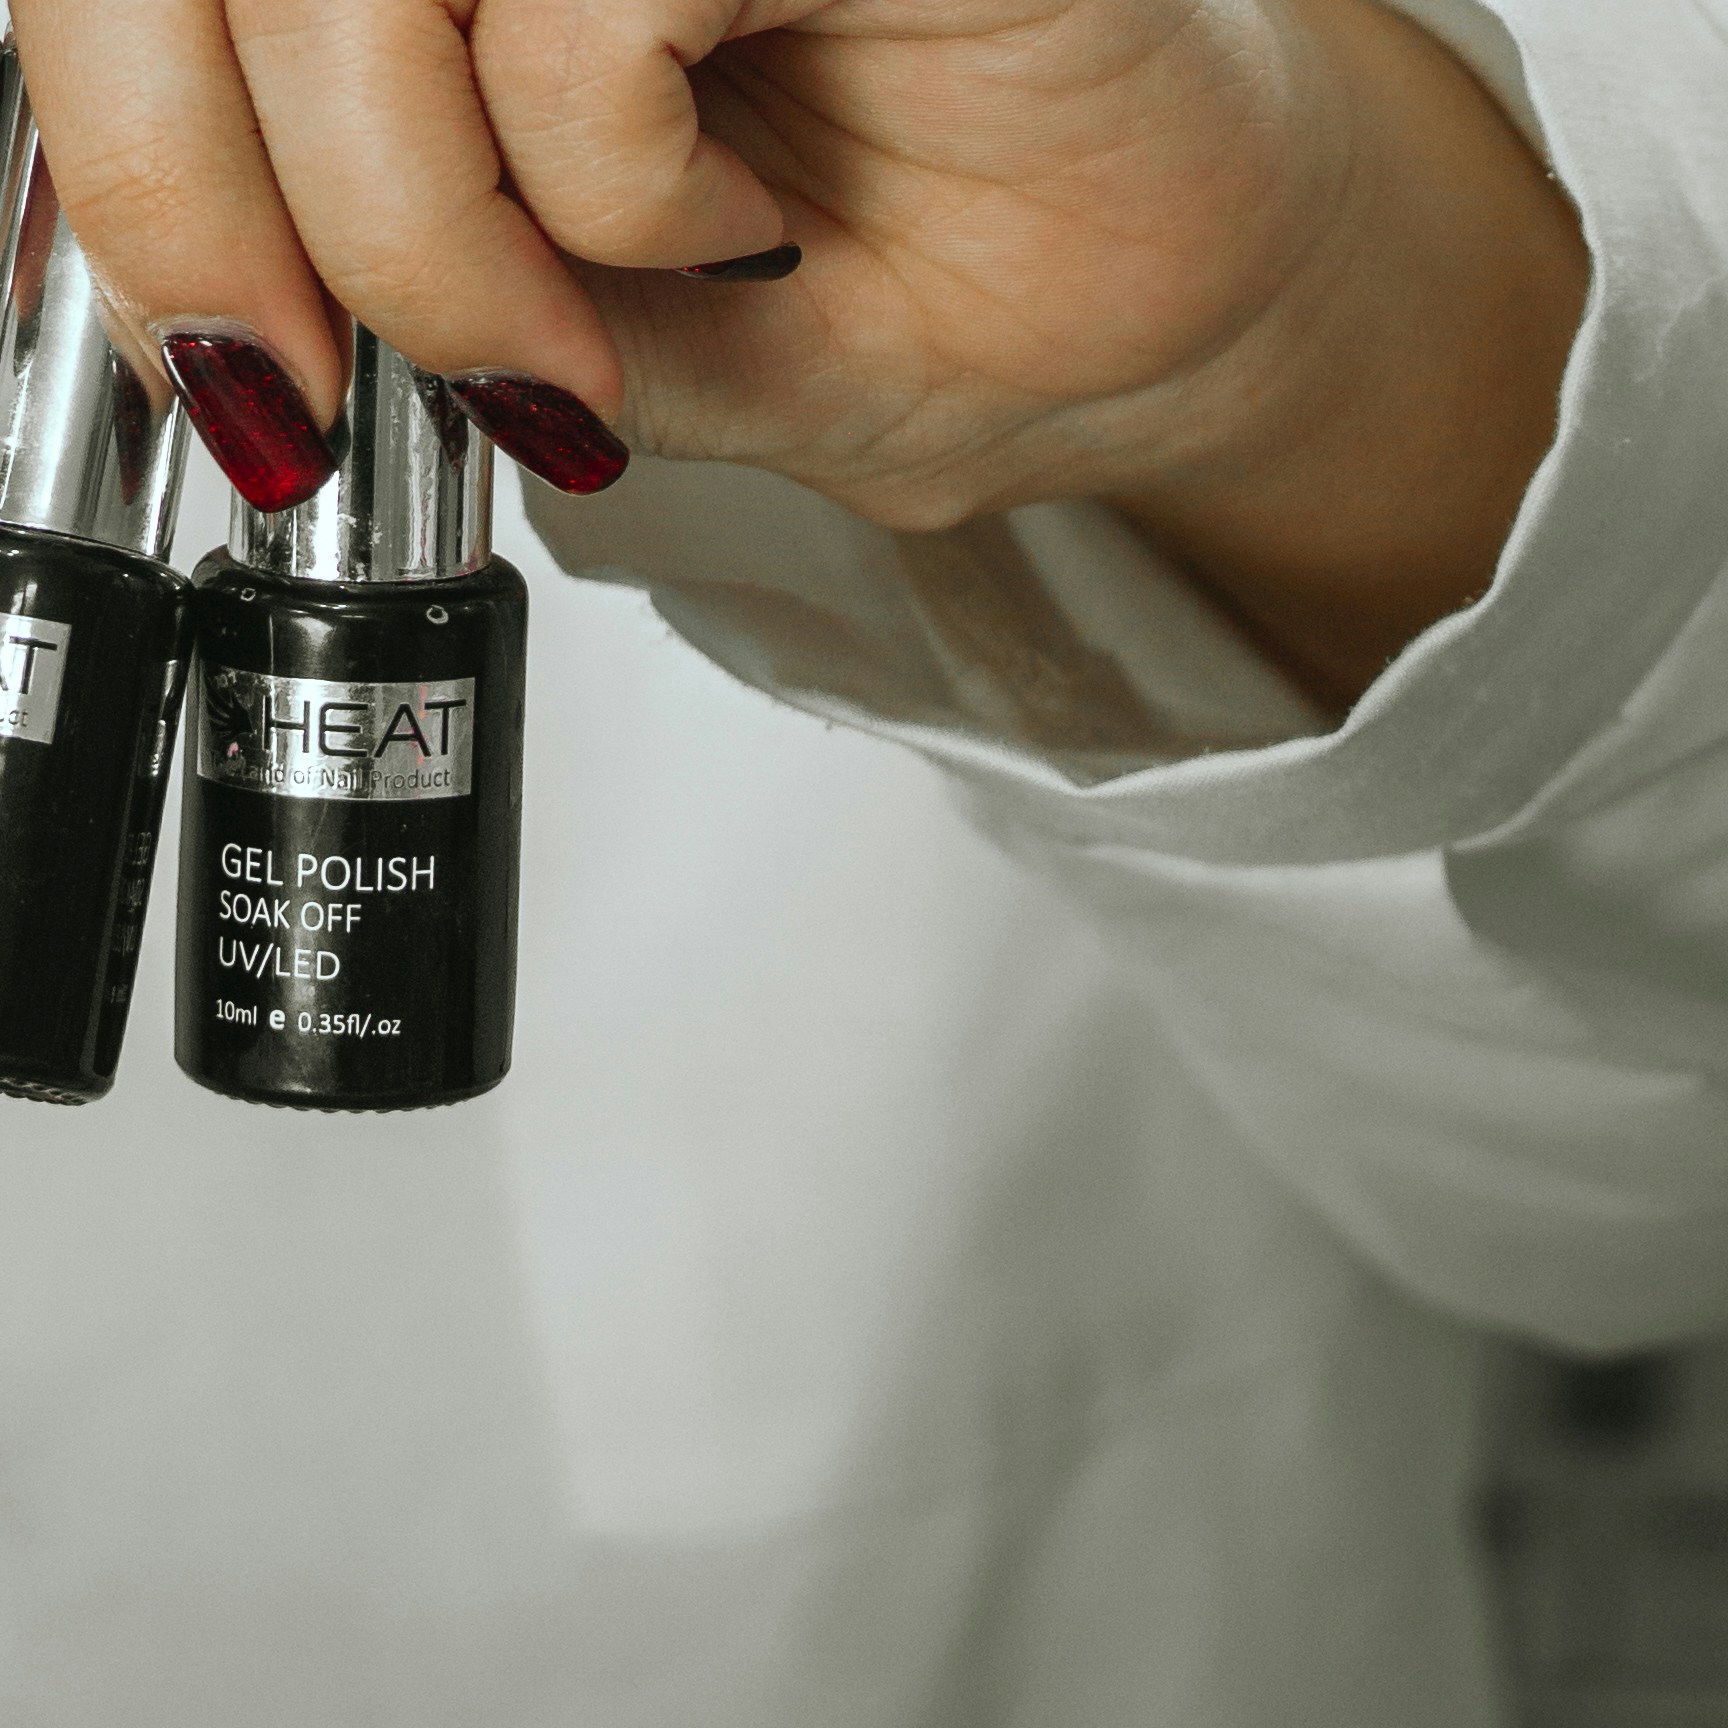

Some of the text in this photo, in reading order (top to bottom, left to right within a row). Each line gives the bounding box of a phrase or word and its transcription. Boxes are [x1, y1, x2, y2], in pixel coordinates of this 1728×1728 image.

[262, 694, 466, 758] HEAT
[293, 766, 314, 785] of
[321, 767, 363, 789] Nail
[372, 767, 451, 789] Product
[221, 843, 435, 891] GEL POLISH
[219, 890, 362, 933] SOAK OFF
[218, 936, 341, 980] UV/LED
[216, 999, 258, 1027] 10ml
